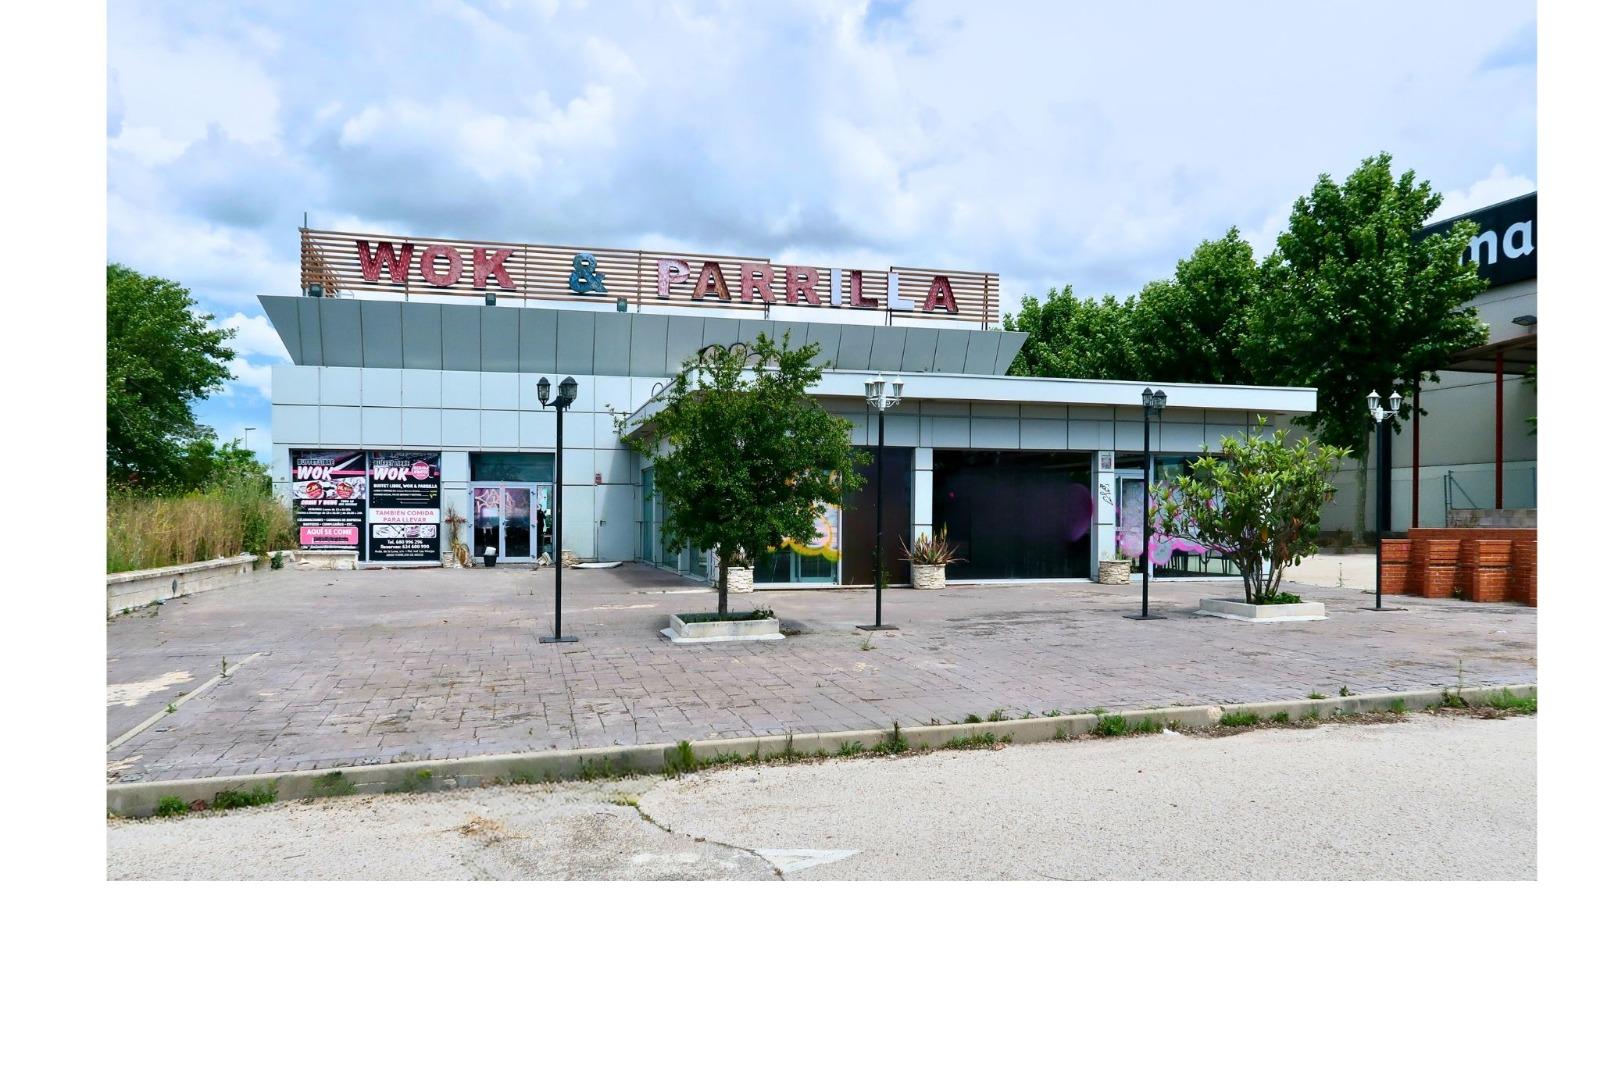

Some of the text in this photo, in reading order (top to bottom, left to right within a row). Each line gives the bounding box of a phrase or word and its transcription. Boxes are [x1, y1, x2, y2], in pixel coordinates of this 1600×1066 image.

[356, 240, 960, 313] WOK & PARRILLA
[297, 466, 333, 481] WOK
[373, 467, 410, 481] WOK
